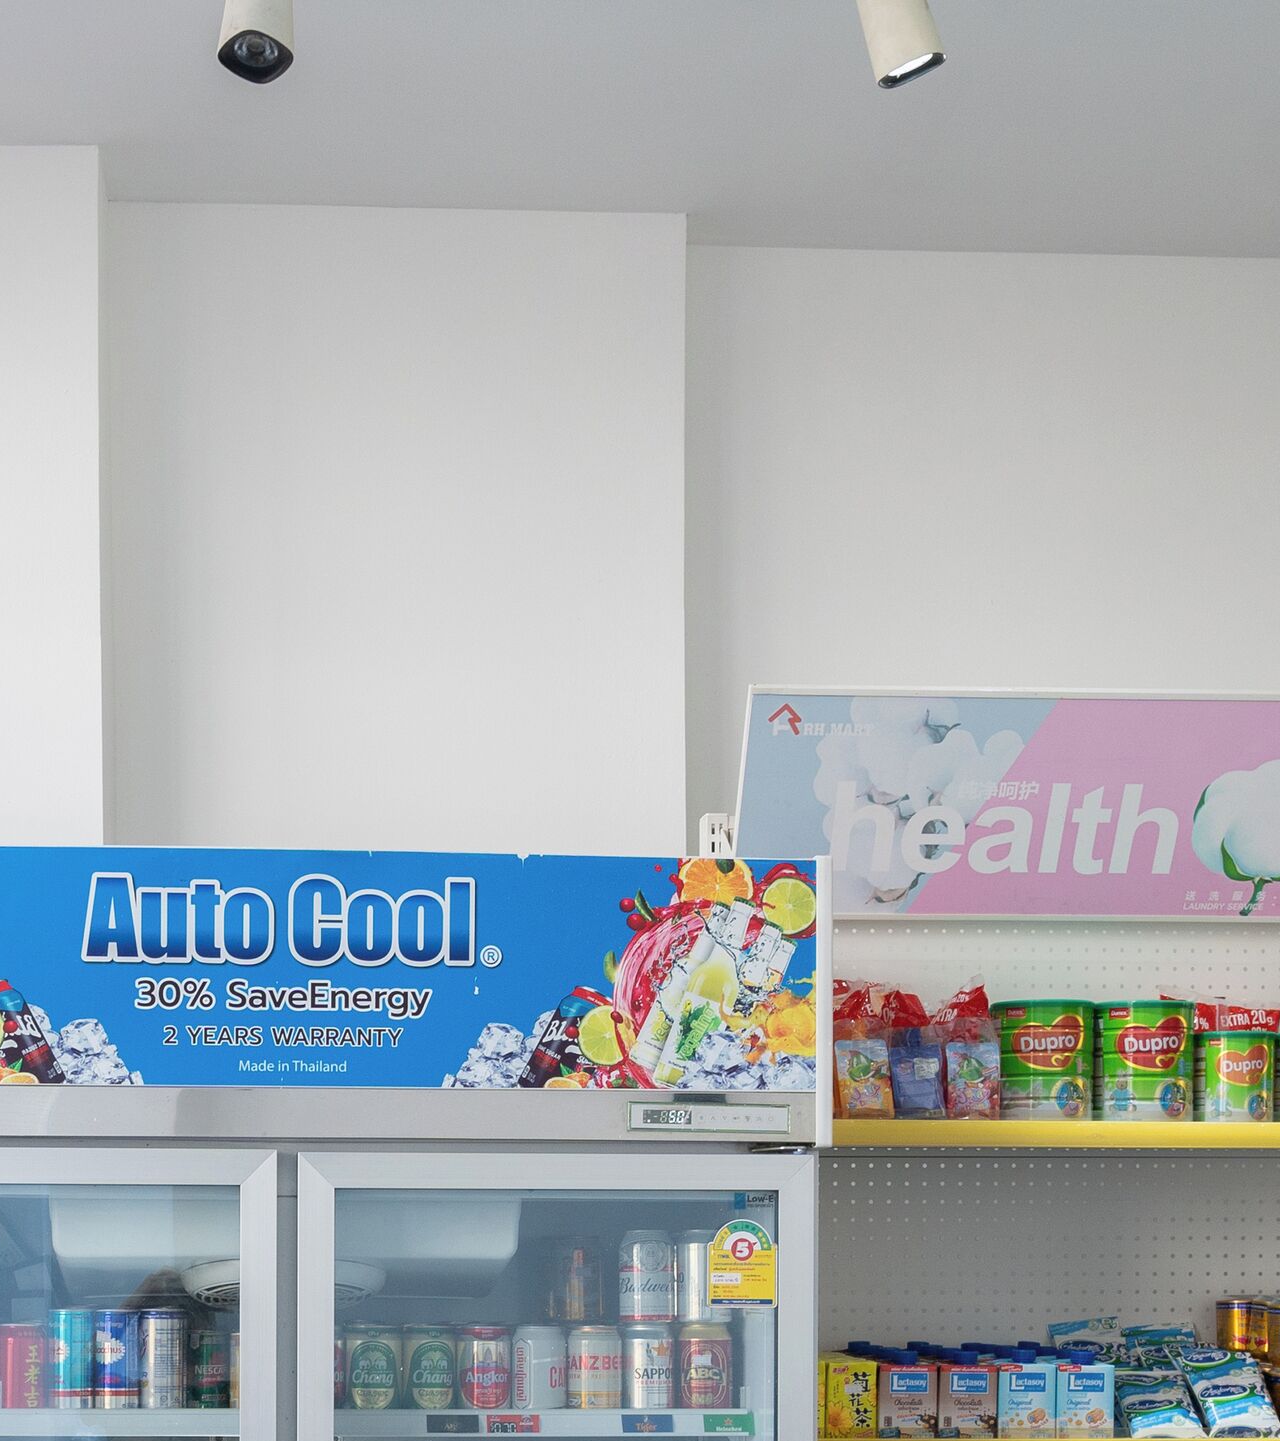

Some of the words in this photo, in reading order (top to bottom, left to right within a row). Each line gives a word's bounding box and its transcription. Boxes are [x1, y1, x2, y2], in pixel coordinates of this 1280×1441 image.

[834, 780, 1181, 876] health
[1182, 902, 1225, 911] LAUNDRY
[1226, 903, 1264, 911] SERVICE
[81, 872, 276, 964] Auto
[288, 873, 477, 967] Cool
[135, 978, 215, 1011] 30%
[226, 981, 432, 1019] SaveEnergy
[1221, 1012, 1250, 1028] EXTRA
[164, 1027, 178, 1045] 2
[185, 1027, 264, 1045] YEARS
[272, 1028, 403, 1047] WARRANTY
[1020, 1032, 1076, 1055] Dupro
[1124, 1033, 1180, 1056] Dupro
[238, 1060, 276, 1073] Made
[280, 1060, 290, 1073] in
[293, 1060, 347, 1073] Thailand
[1222, 1057, 1264, 1076] Dupro
[746, 1194, 775, 1203] Low-E
[735, 1241, 749, 1257] 5
[23, 1343, 41, 1408] 王老吉
[352, 1369, 394, 1387] Chang
[412, 1369, 453, 1387] Chang
[465, 1370, 509, 1388] Angkor
[686, 1365, 722, 1381] ABC
[892, 1371, 928, 1392] Lactasoy
[952, 1371, 987, 1392] Lactasoy
[1011, 1371, 1045, 1392] Lactasoy
[1070, 1371, 1104, 1392] Lactasoy
